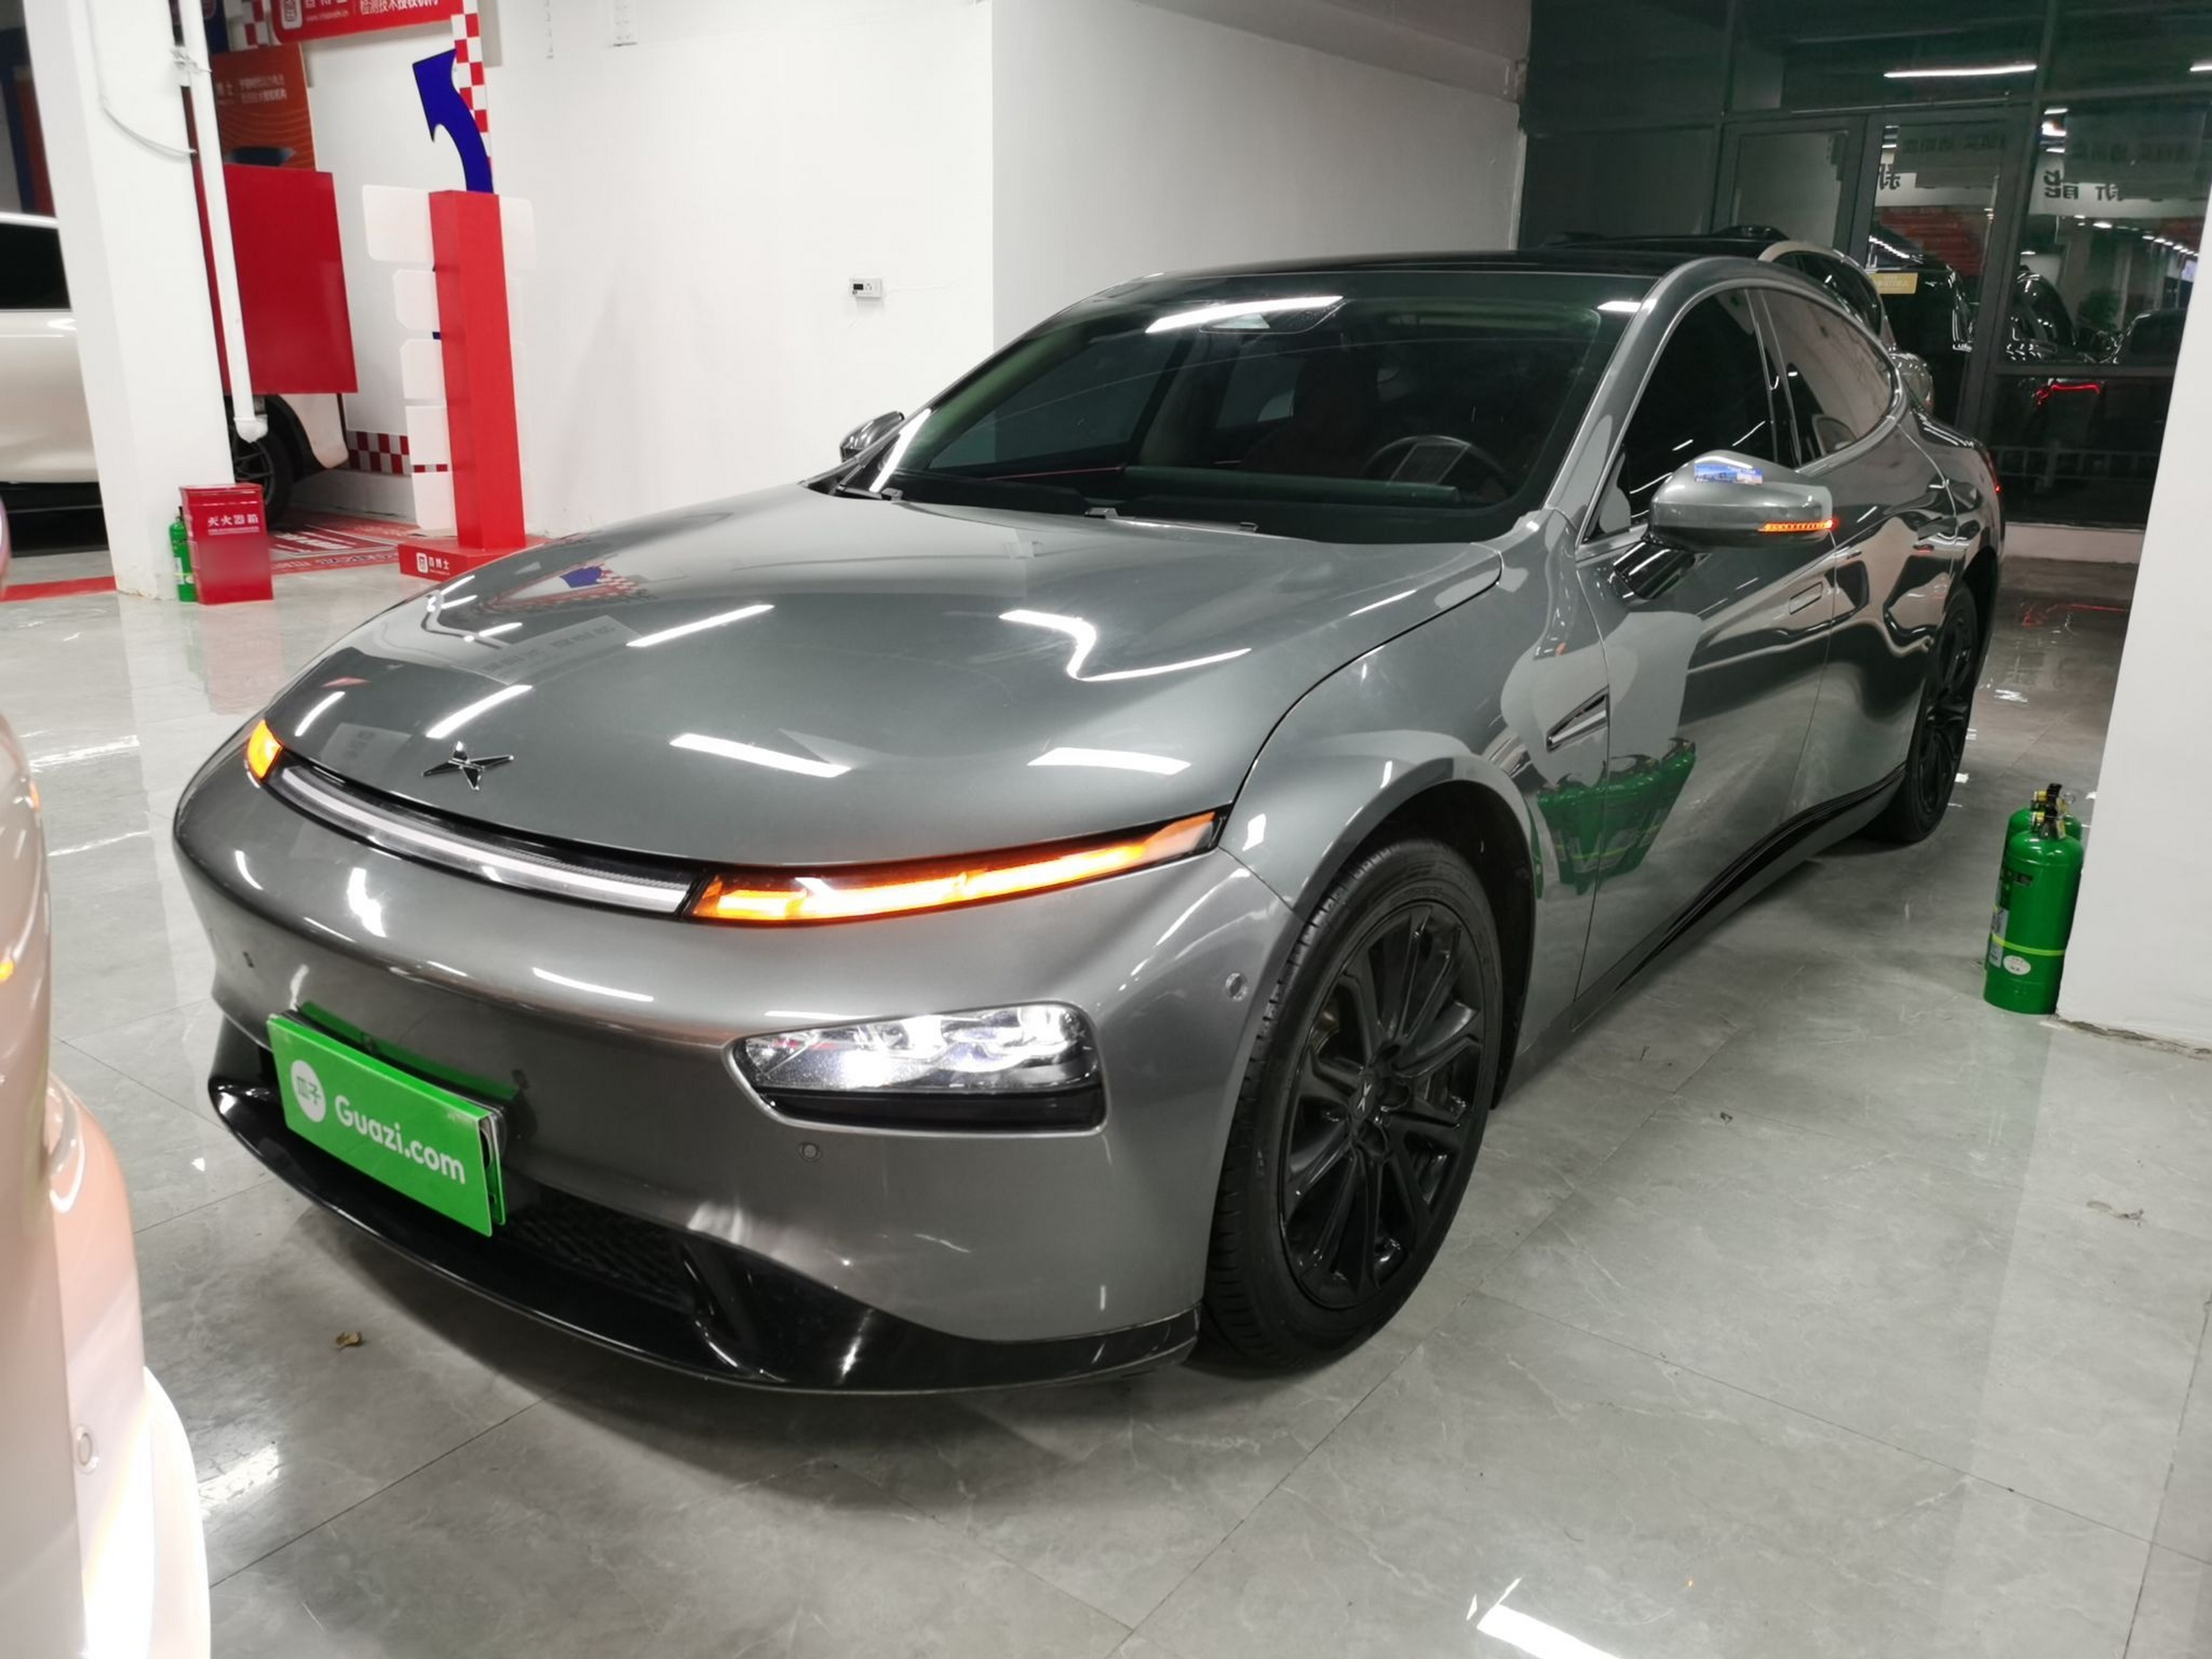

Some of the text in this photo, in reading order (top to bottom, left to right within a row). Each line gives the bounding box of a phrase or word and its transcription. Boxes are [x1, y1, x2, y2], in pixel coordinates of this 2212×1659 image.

[208, 514, 259, 527] 灭火器箱
[335, 1095, 466, 1185] Guazi.com
